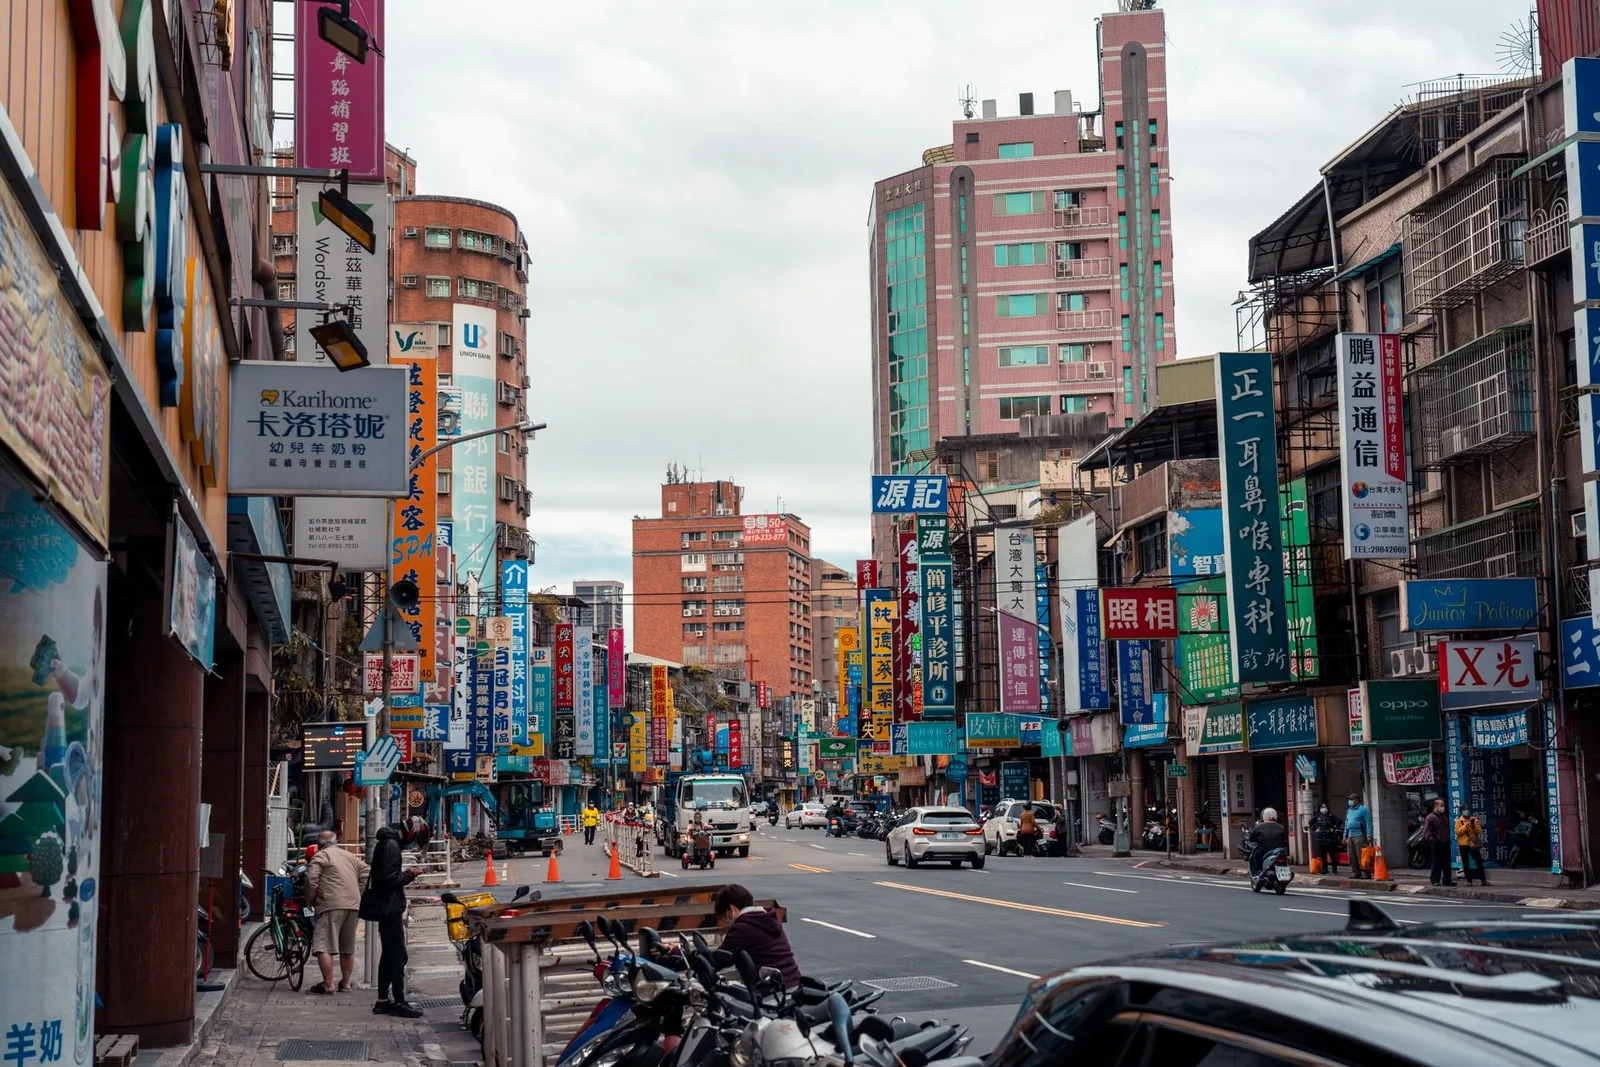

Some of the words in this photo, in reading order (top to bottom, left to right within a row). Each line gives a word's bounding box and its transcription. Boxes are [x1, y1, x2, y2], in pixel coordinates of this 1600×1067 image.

[282, 390, 372, 409] Karihome
[1349, 338, 1379, 468] 鵬益通信
[247, 411, 386, 440] 卡洛塔妮
[269, 442, 366, 455] 幼兒羊奶粉
[463, 391, 488, 533] 聯邦銀行
[877, 479, 942, 509] 源記
[1231, 367, 1275, 635] 正一耳鼻喉專科
[393, 532, 433, 565] SPA
[926, 568, 949, 682] 簡修平診所
[1108, 597, 1175, 630] 照相
[1413, 601, 1467, 626] Junior
[1011, 627, 1028, 696] 遠傳電信
[1241, 648, 1287, 671] 診所
[970, 716, 1018, 736] 皮膚科
[451, 752, 472, 767] 行
